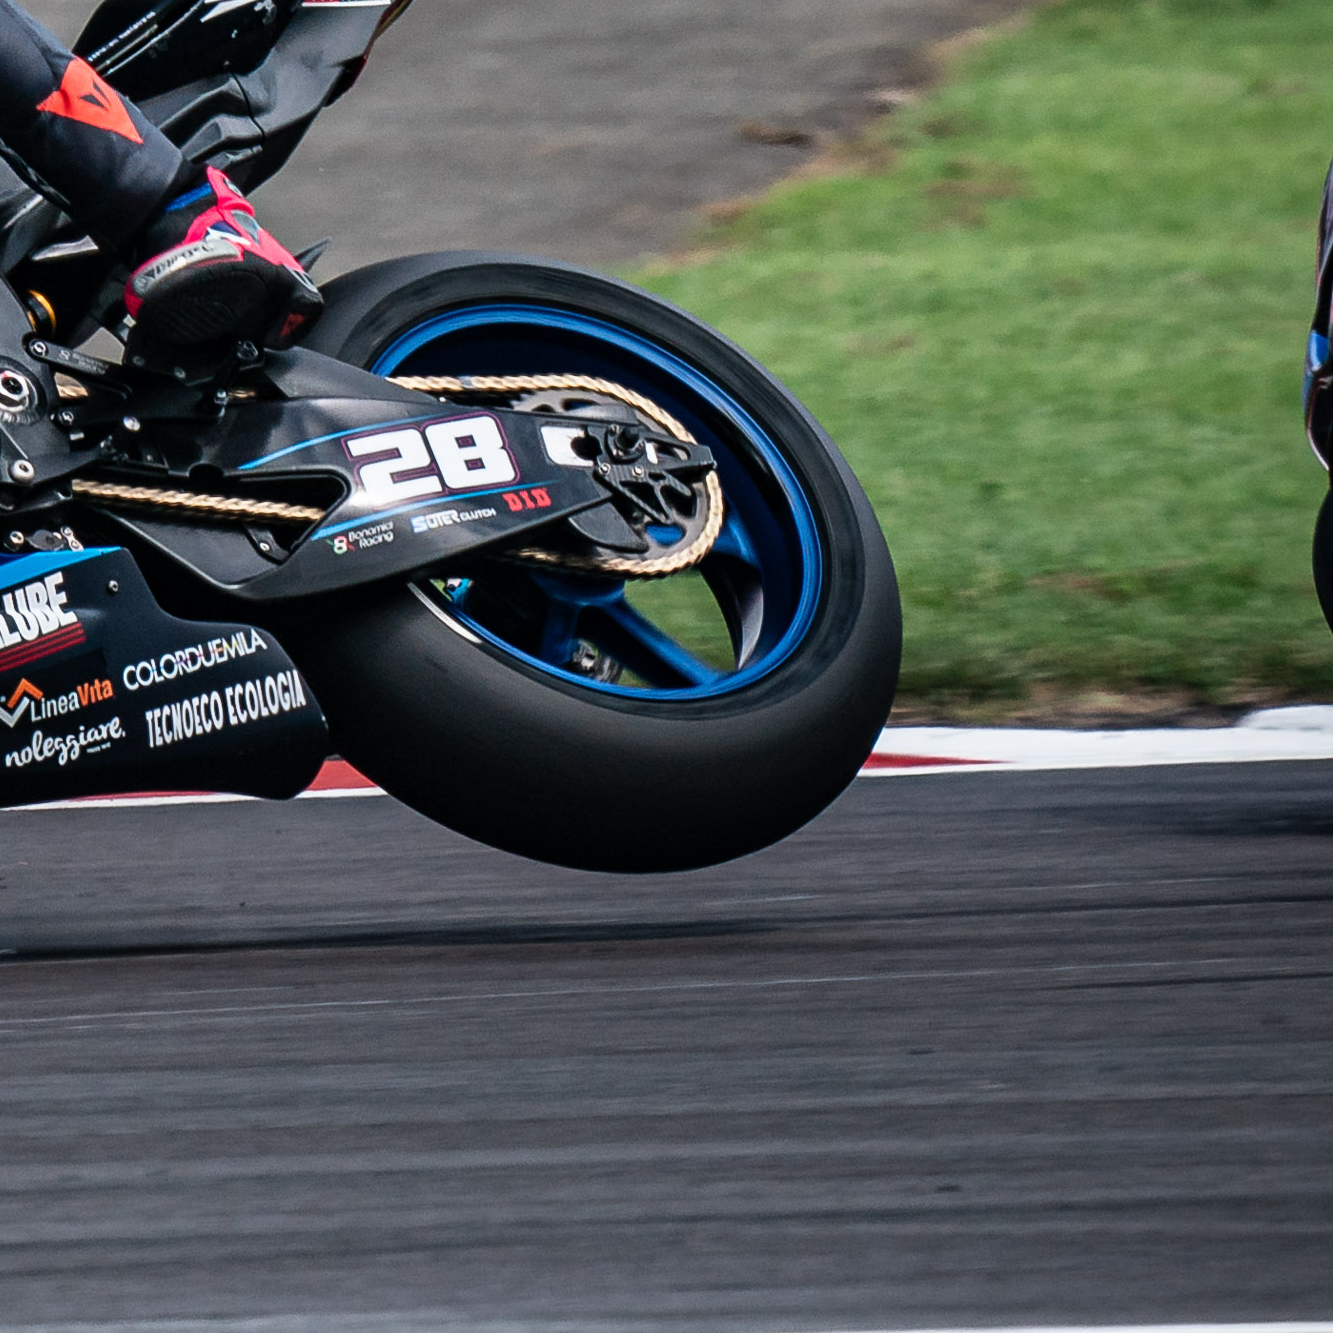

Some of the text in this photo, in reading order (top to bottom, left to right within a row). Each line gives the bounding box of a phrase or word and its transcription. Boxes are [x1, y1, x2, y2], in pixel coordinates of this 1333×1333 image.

[345, 414, 519, 508] 28
[359, 530, 394, 550] Racing
[122, 627, 269, 691] COLORDUEMILA
[30, 677, 114, 722] LineaVita
[144, 668, 307, 749] TECNOECO ECOLOGIA
